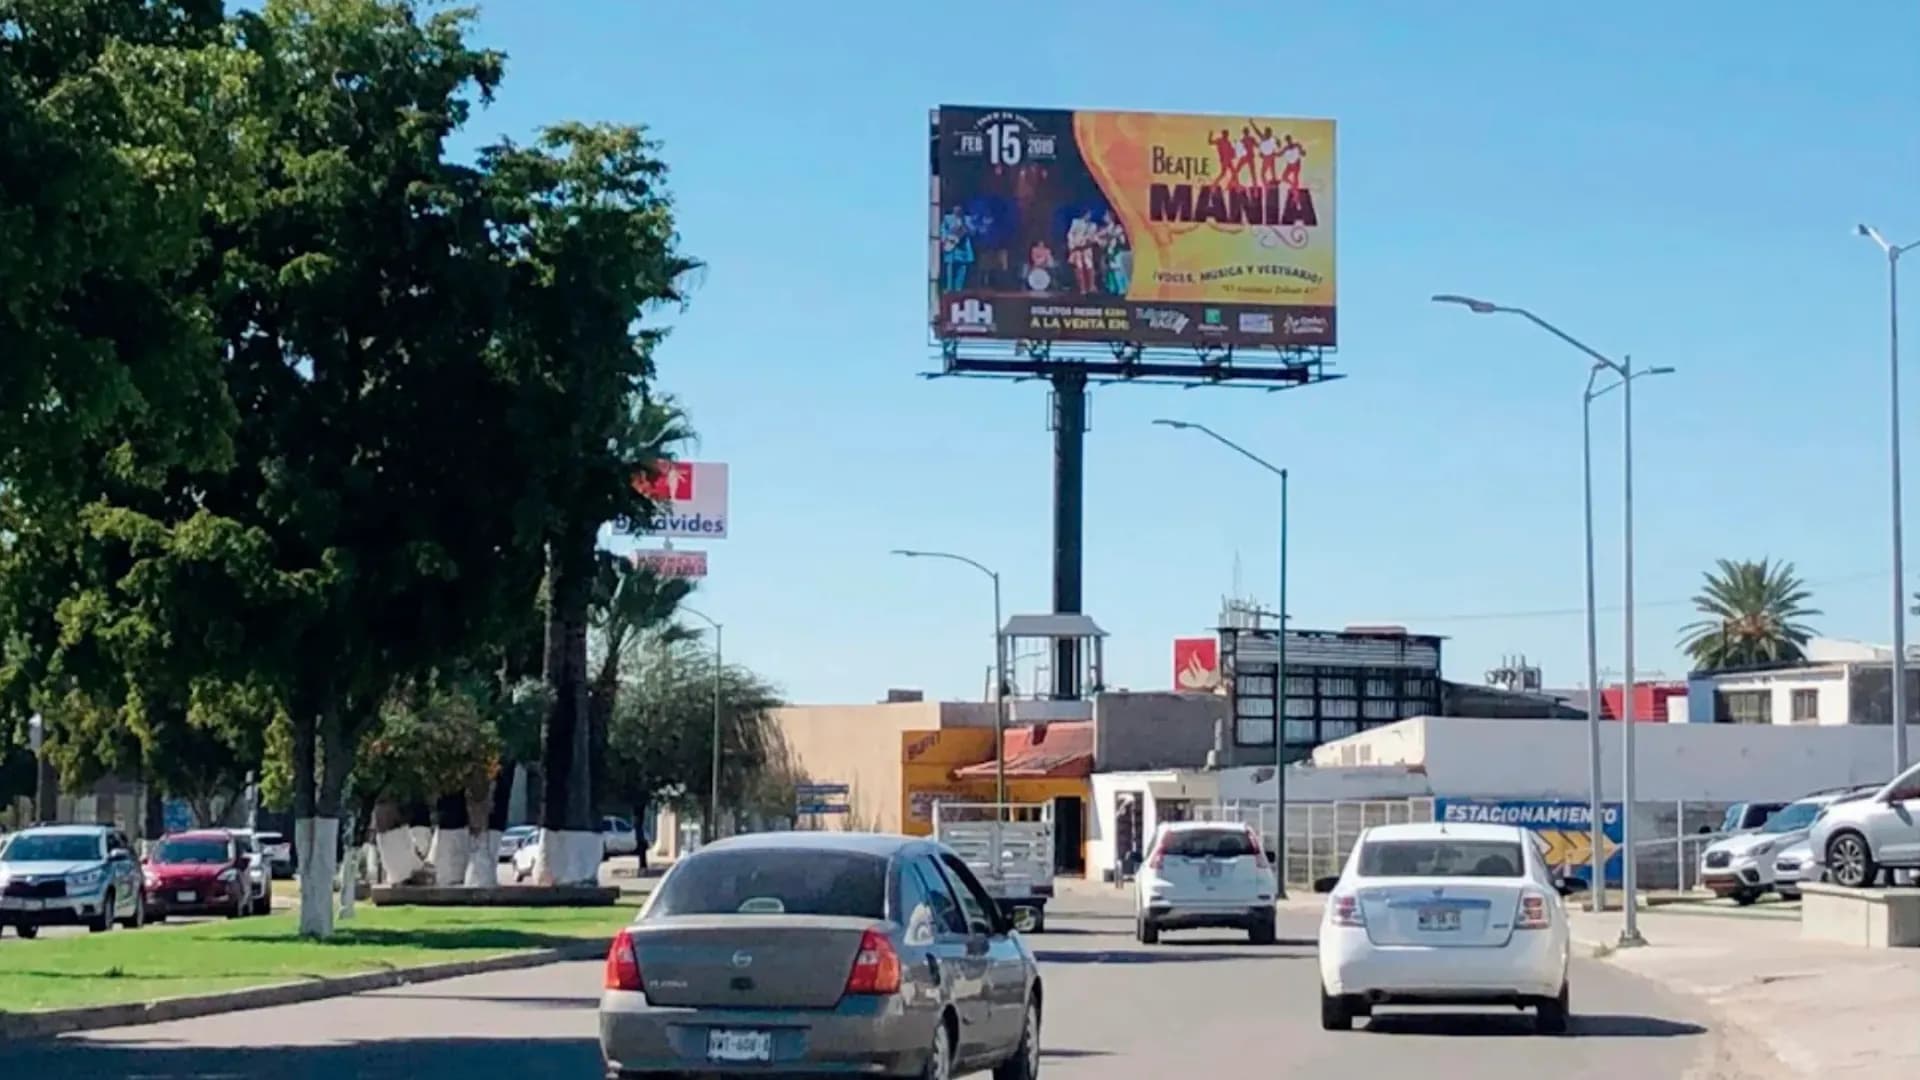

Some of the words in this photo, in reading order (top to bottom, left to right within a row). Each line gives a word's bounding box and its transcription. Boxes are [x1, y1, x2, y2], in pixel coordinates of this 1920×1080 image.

[961, 136, 983, 153] FEB
[986, 123, 1022, 166] 15
[1150, 183, 1318, 227] MANIA
[1246, 264, 1254, 275] Y
[1030, 317, 1041, 330] A
[1042, 317, 1061, 330] LA
[1063, 318, 1106, 331] VENTA
